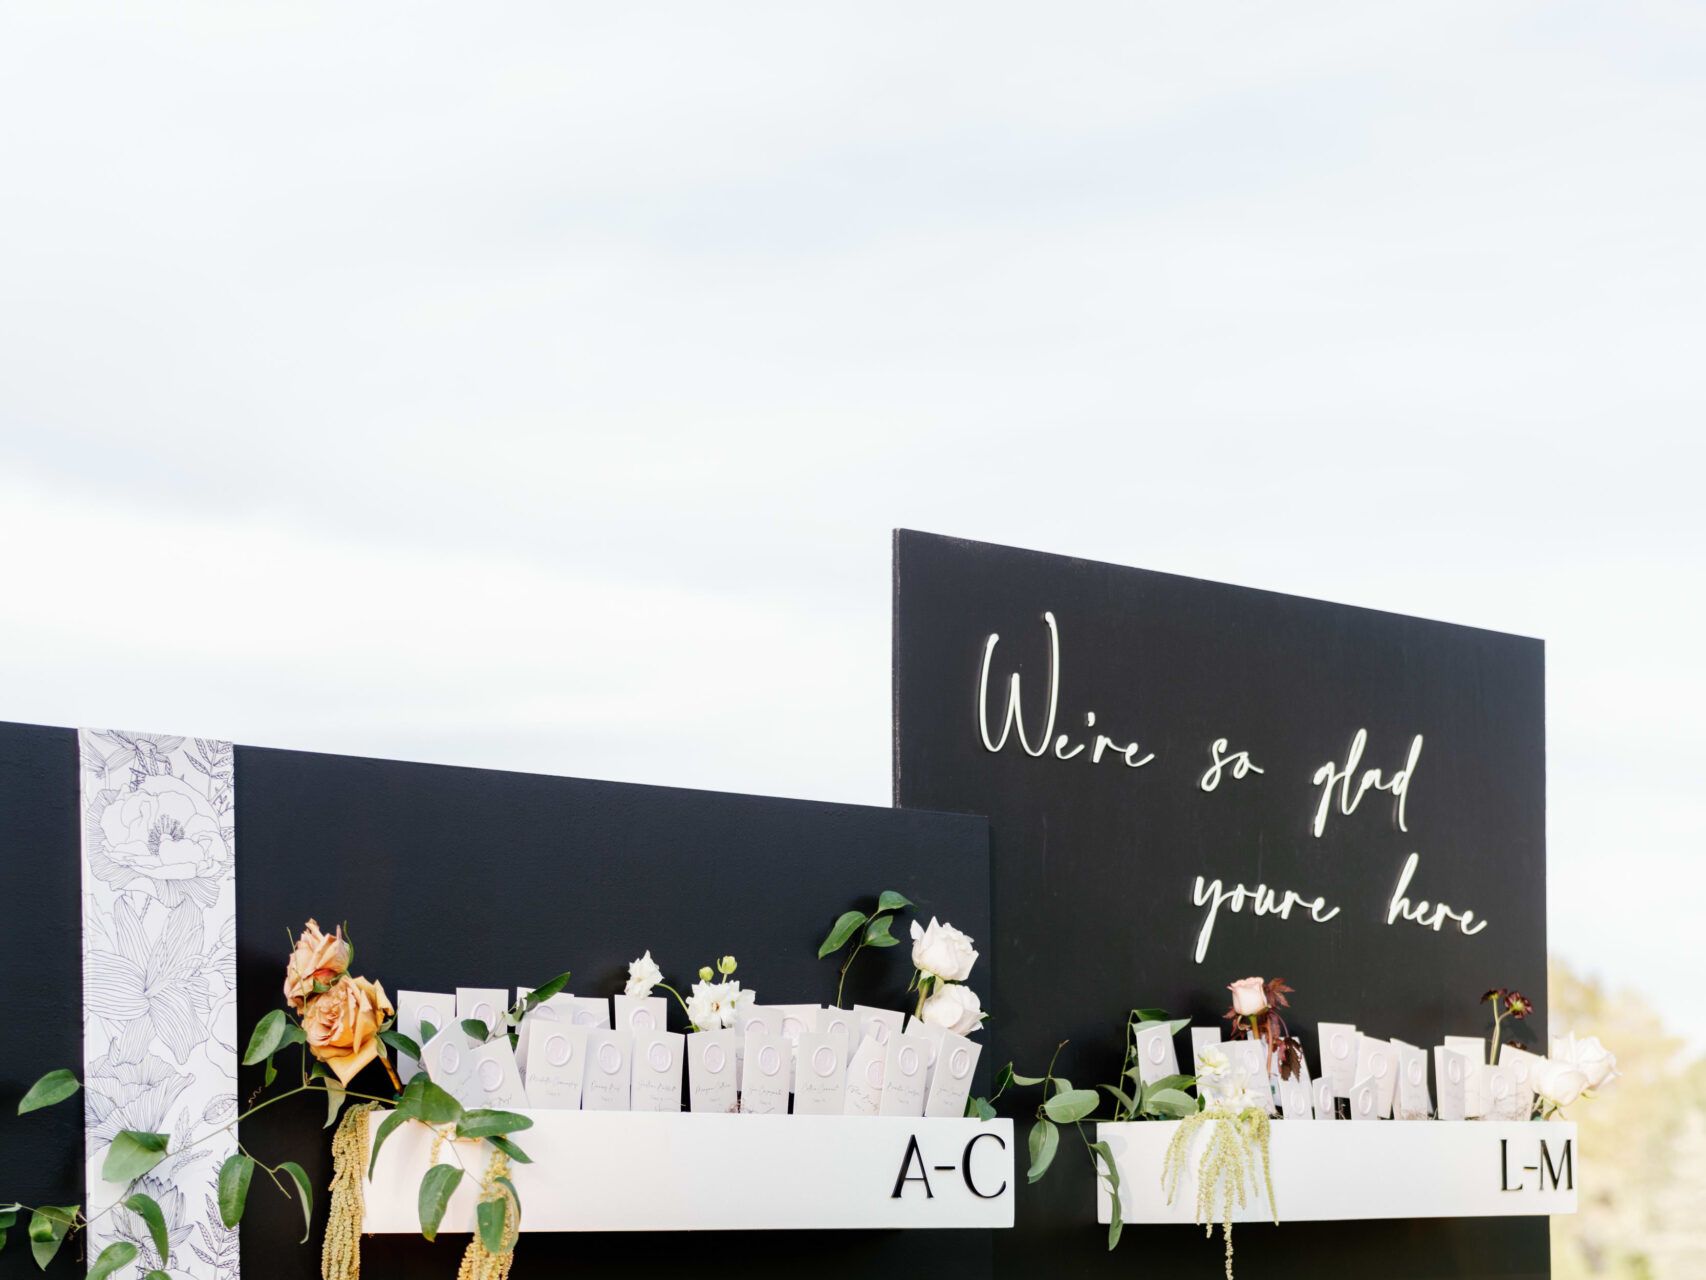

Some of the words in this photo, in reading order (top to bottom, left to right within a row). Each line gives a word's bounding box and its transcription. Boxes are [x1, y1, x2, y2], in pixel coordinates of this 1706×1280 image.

[979, 611, 1155, 768] We're
[1200, 737, 1265, 792] so
[1312, 727, 1424, 838] glad
[1193, 875, 1341, 964] youre
[1387, 852, 1488, 936] here
[890, 1133, 1007, 1199] A-C
[1499, 1138, 1573, 1191] L-M
